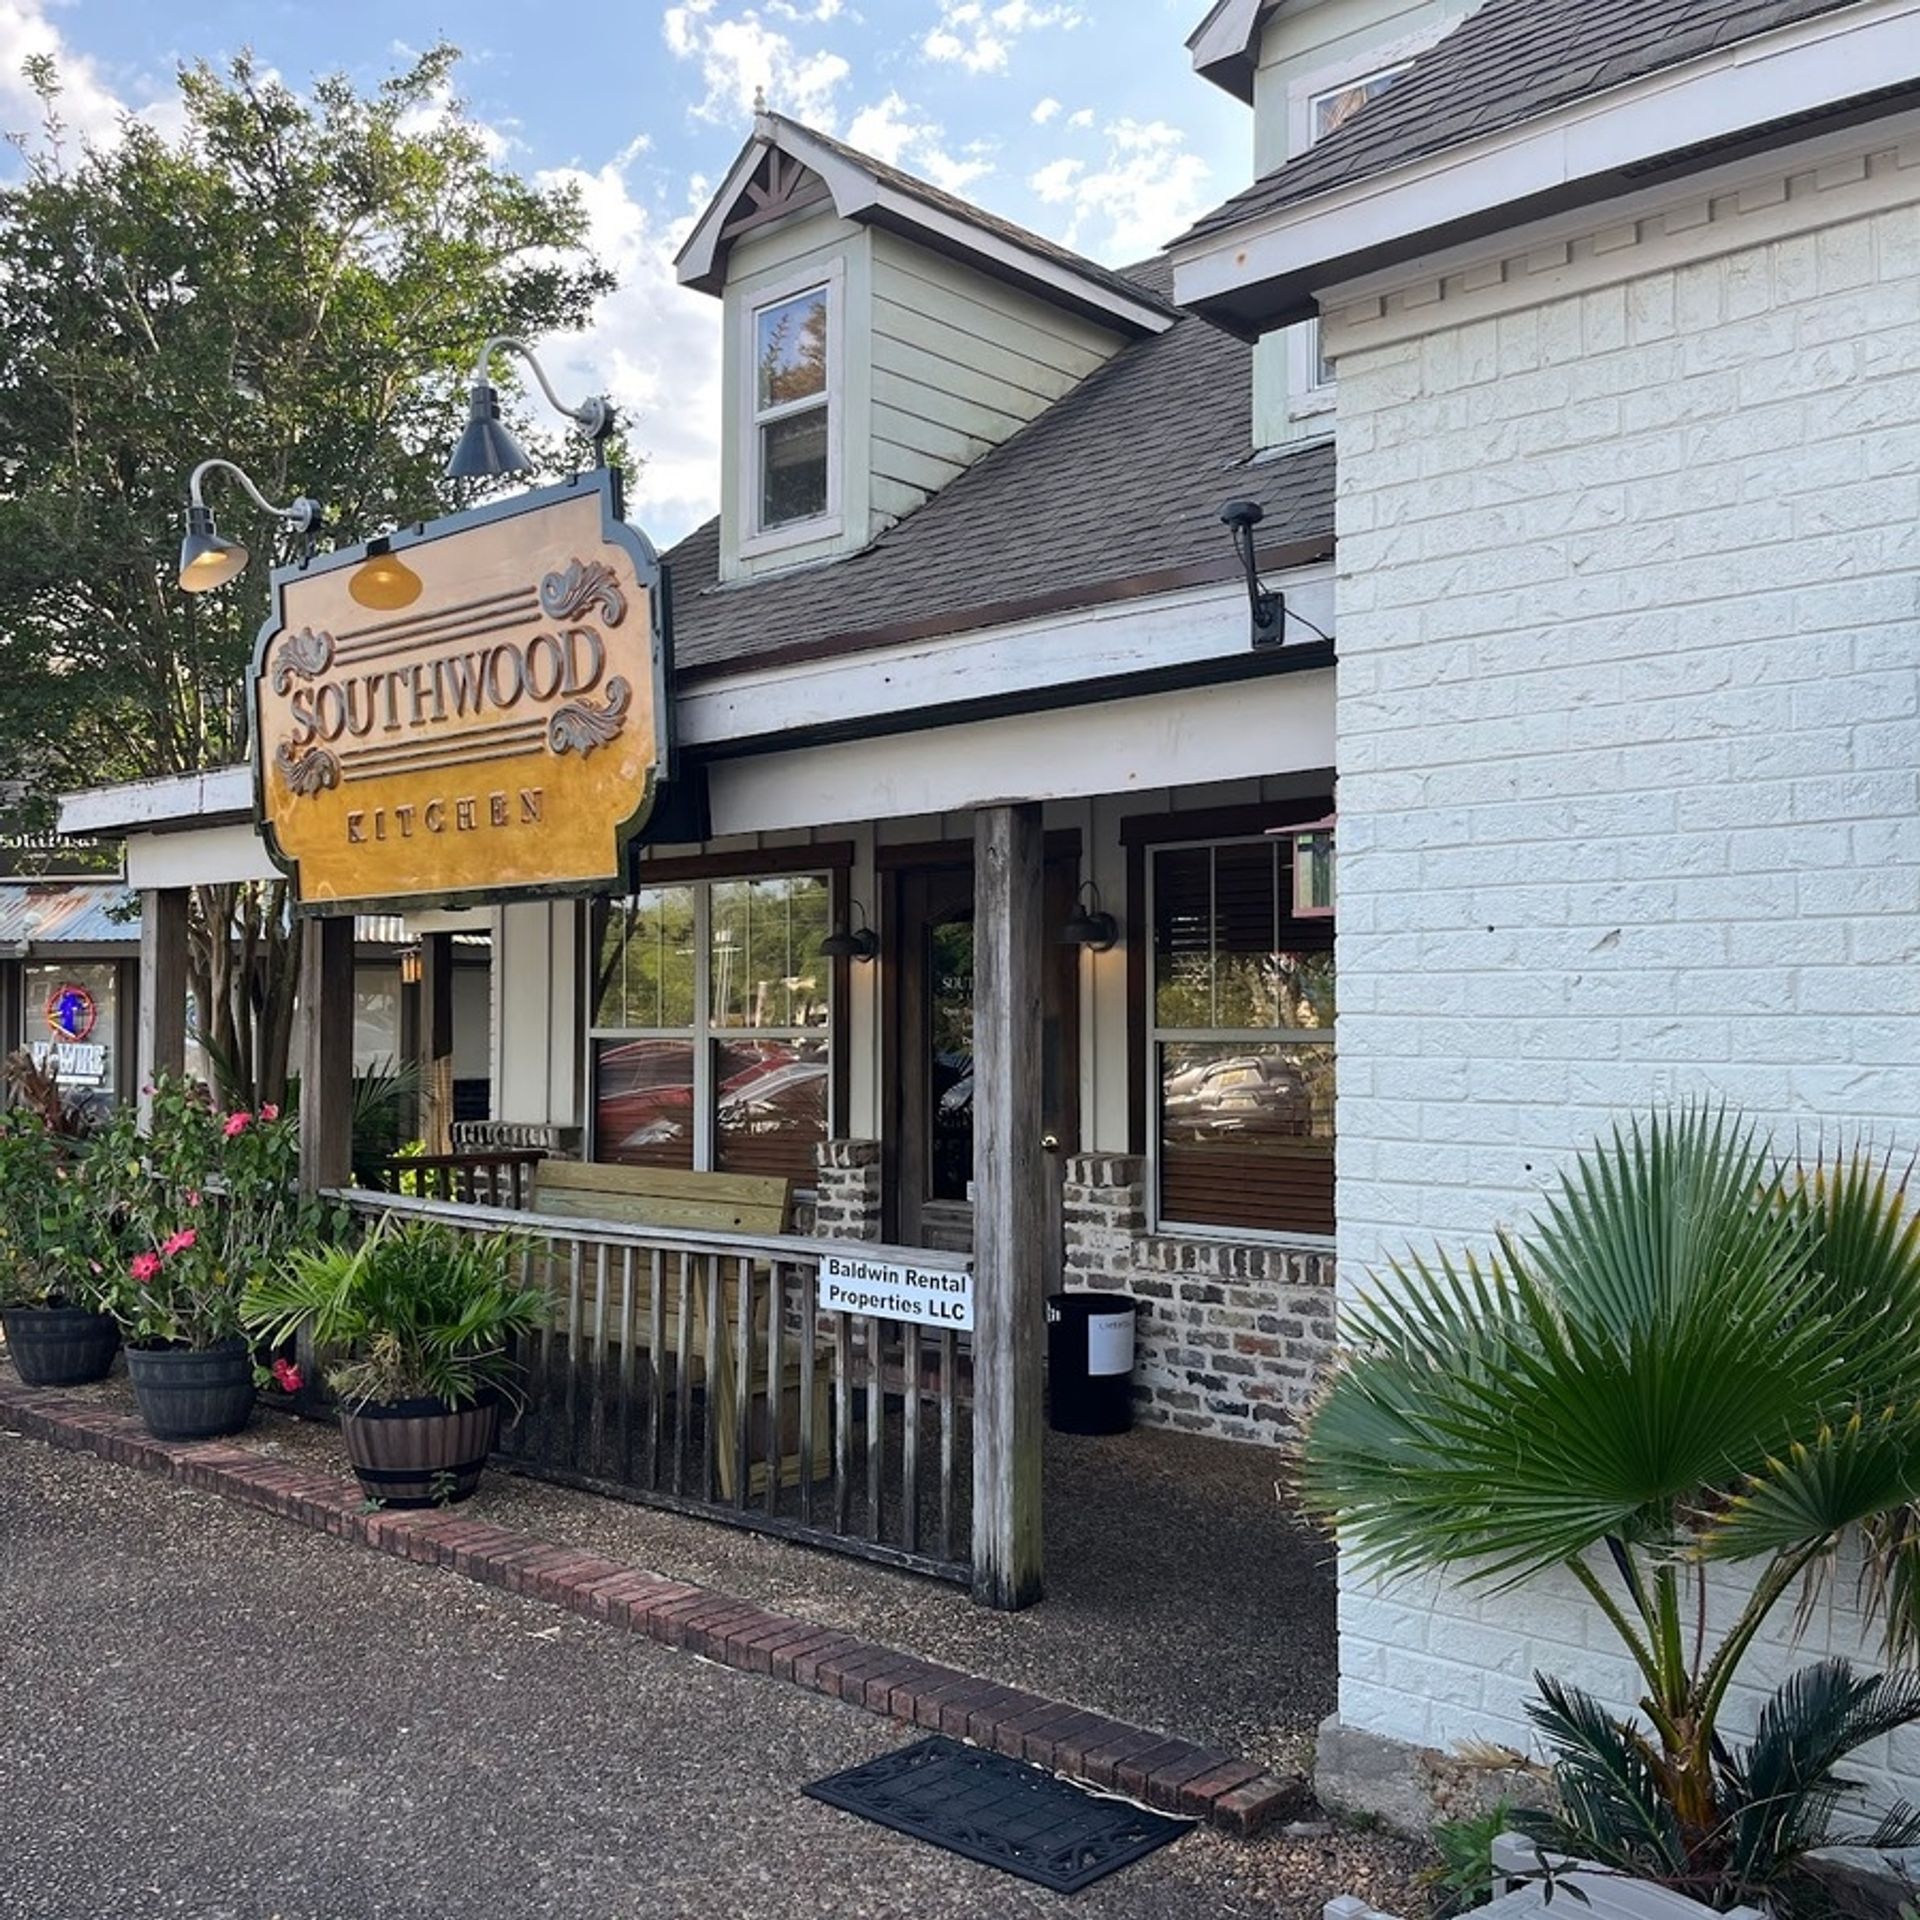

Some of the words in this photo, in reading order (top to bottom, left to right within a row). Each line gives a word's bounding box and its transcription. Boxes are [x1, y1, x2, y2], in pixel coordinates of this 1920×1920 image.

[290, 624, 606, 746] SOUTHWOOD
[346, 786, 545, 844] KITCHEN
[829, 1258, 899, 1284] Baldwin
[905, 1269, 966, 1294] Rental
[829, 1284, 922, 1315] Properties
[929, 1299, 965, 1321] LLC
